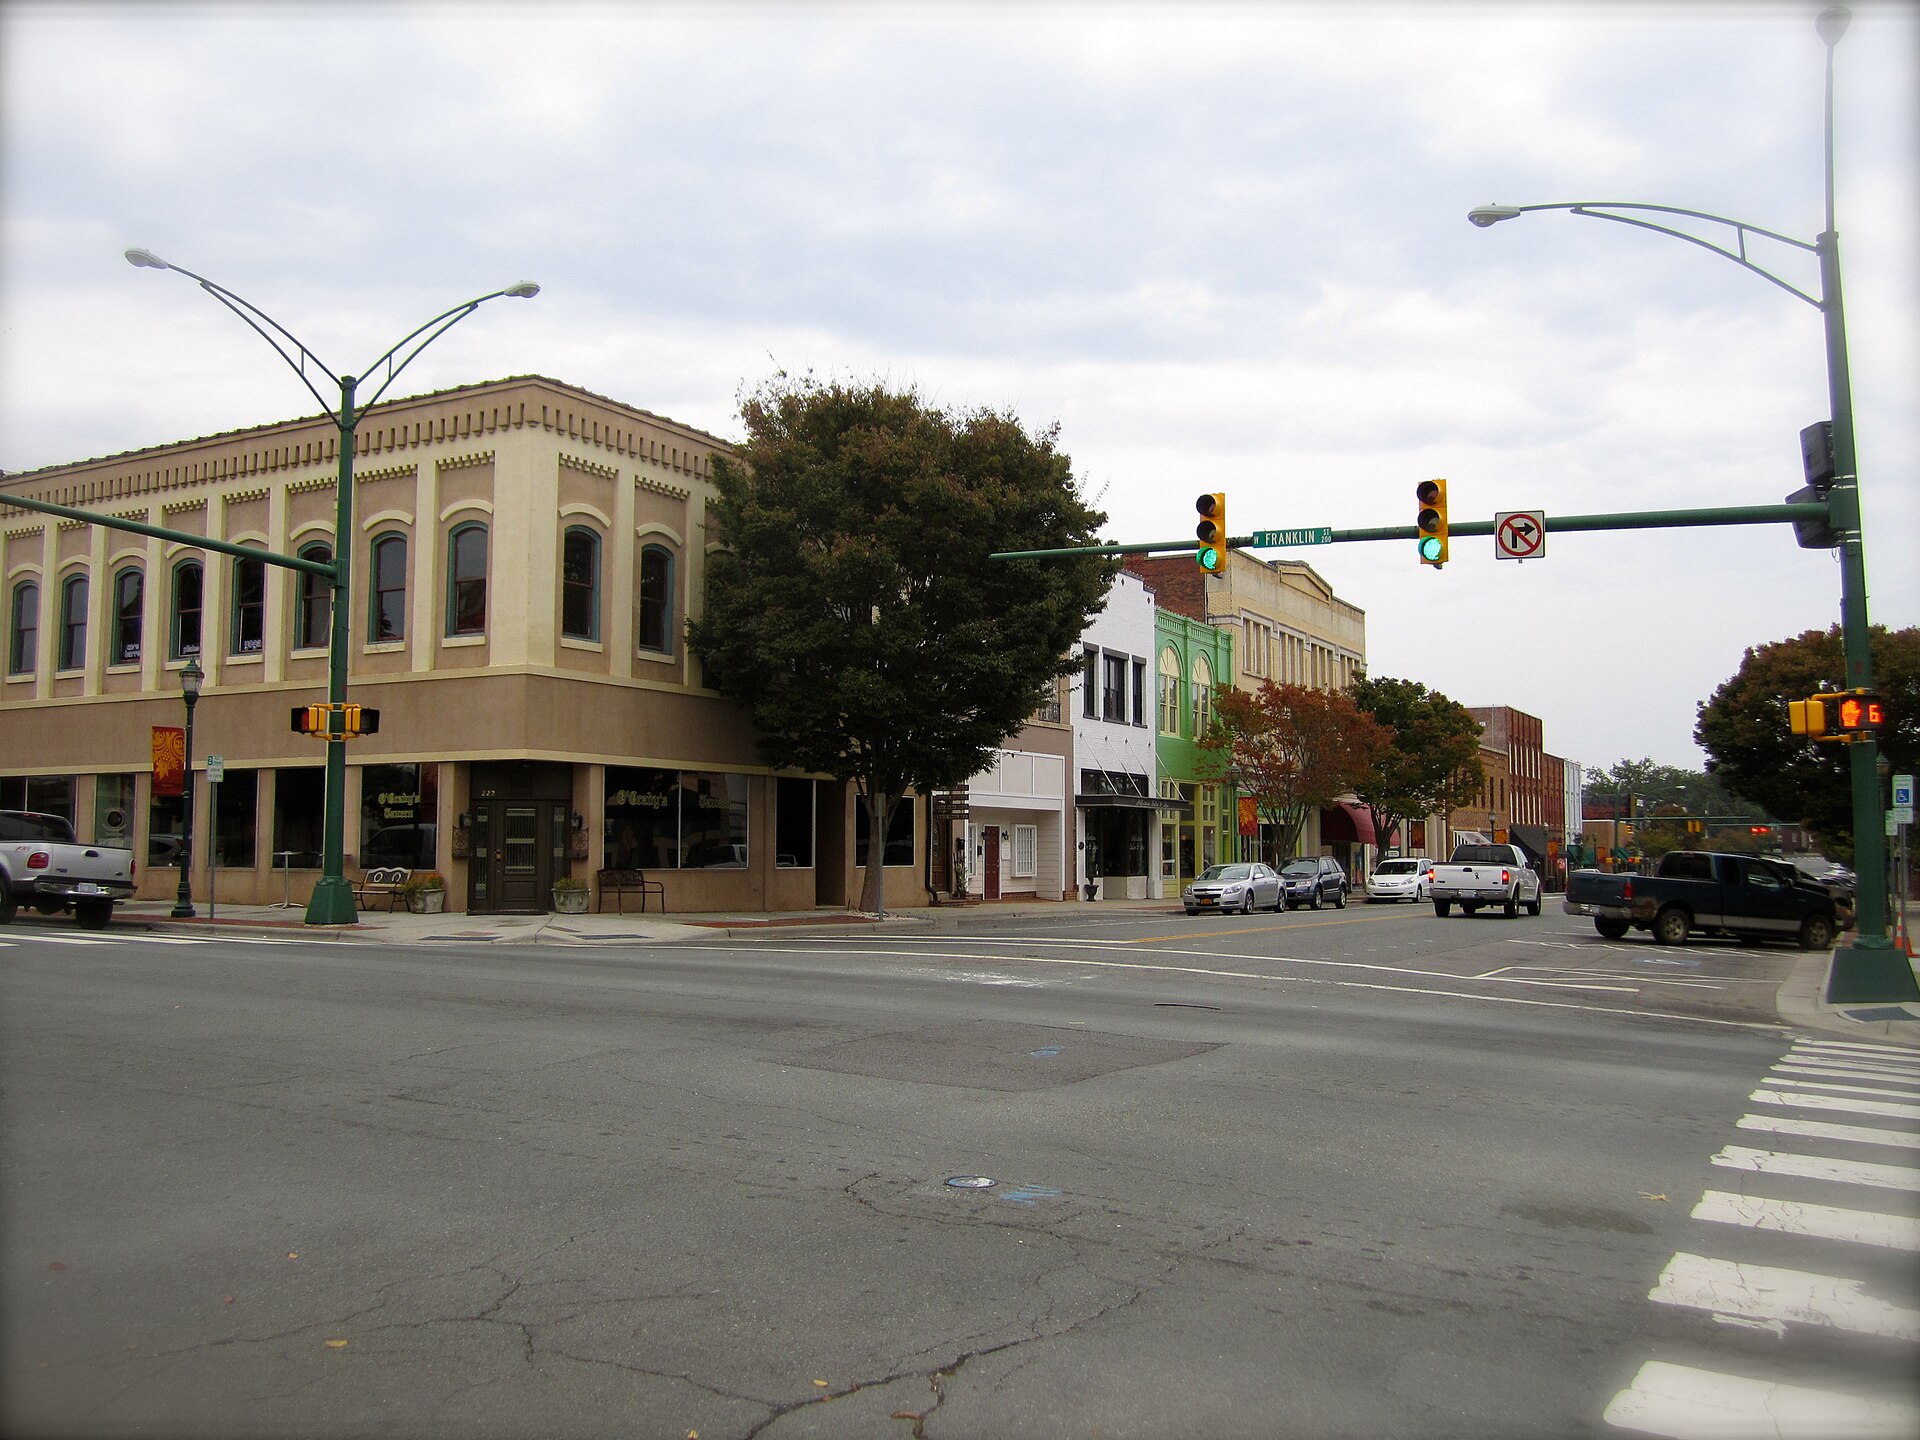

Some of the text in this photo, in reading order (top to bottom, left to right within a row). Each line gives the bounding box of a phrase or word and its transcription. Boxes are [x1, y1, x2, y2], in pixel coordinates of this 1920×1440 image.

[1253, 528, 1330, 546] W FRANKLIN ST
[1321, 535, 1332, 543] 200
[243, 639, 262, 651] yoga
[1868, 704, 1880, 723] 6
